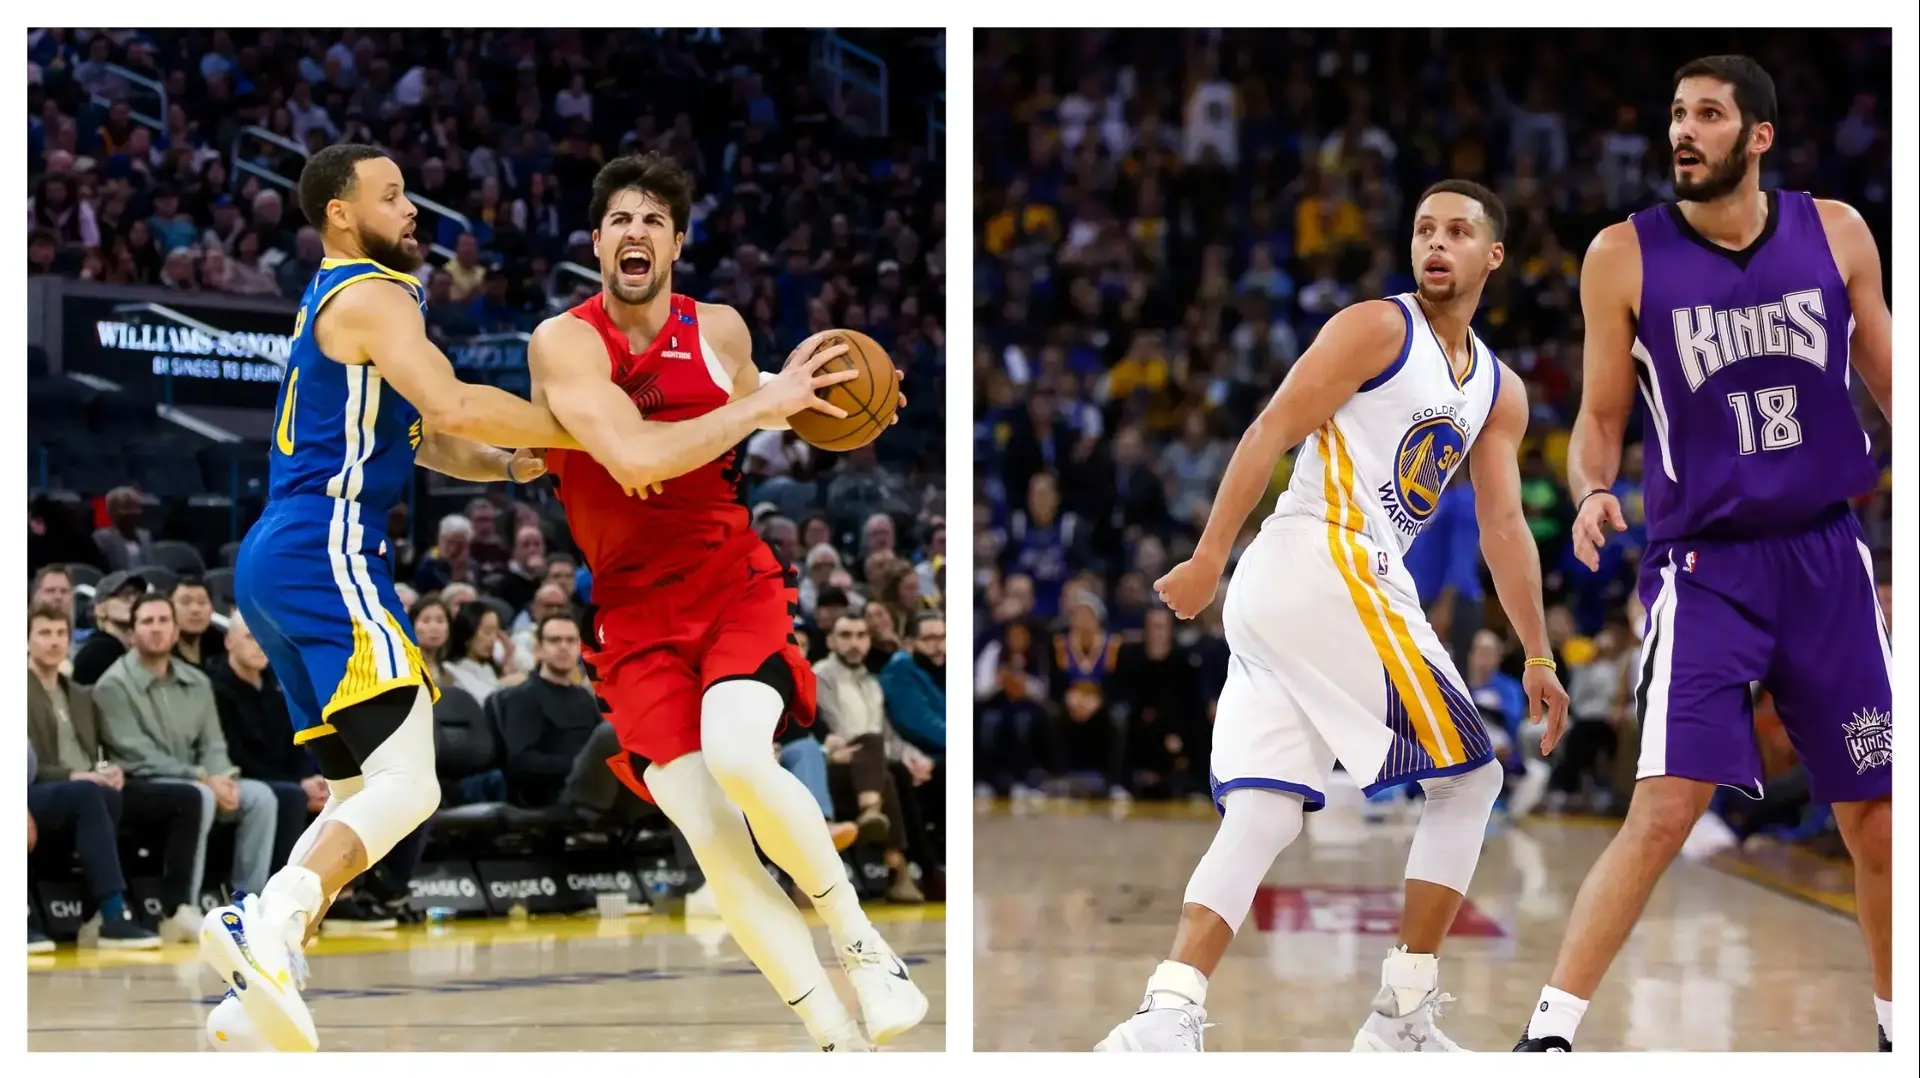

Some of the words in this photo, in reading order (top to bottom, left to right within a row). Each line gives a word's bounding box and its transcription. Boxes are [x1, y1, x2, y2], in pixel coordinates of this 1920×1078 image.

[1672, 288, 1828, 393] KINGS
[222, 361, 240, 380] TO
[1412, 405, 1457, 422] GOLDEN
[1727, 385, 1803, 456] 18
[1437, 444, 1460, 471] 30
[1850, 729, 1892, 761] KINGS
